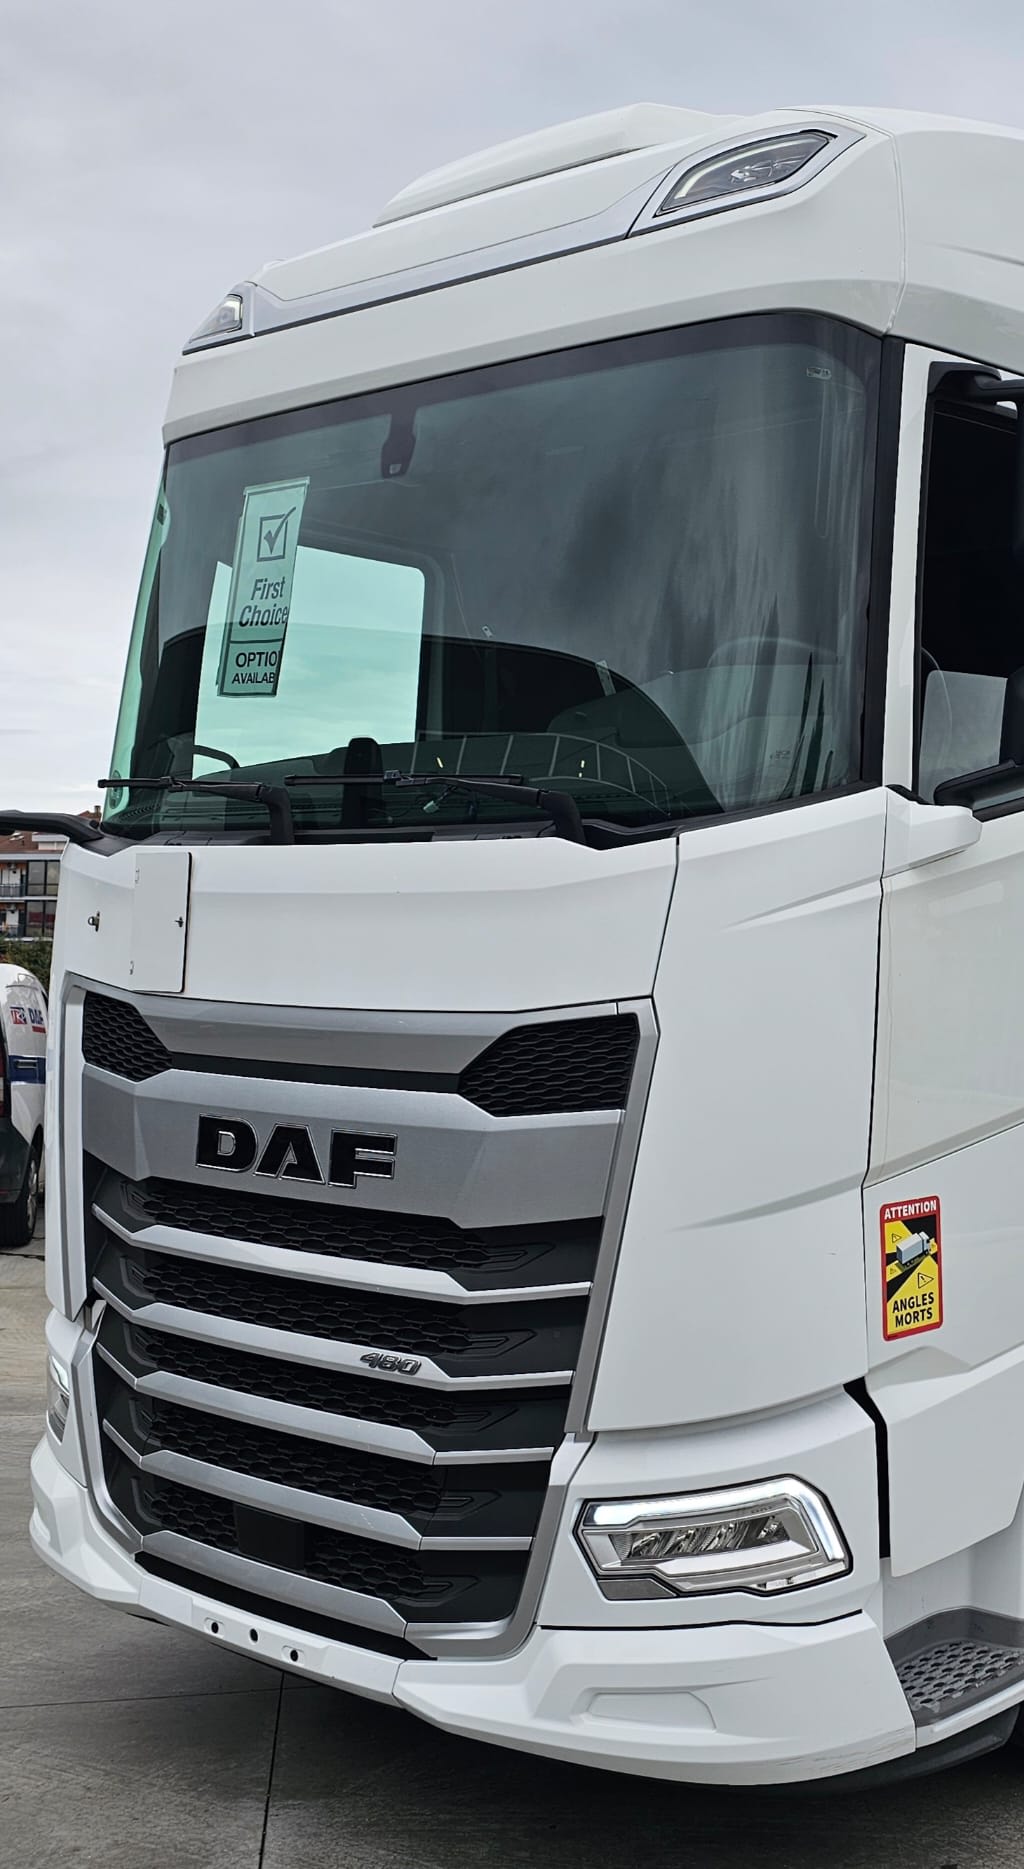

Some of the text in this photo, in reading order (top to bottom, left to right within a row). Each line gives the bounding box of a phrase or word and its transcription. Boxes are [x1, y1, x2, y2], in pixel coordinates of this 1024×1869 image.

[250, 576, 287, 601] First
[238, 604, 289, 628] Choice
[235, 650, 280, 668] OPTIO
[195, 1113, 398, 1189] DAF
[884, 1200, 937, 1221] ATTENTION
[892, 1291, 935, 1314] ANGLES
[895, 1307, 933, 1329] MORTS
[360, 1352, 422, 1376] 480
